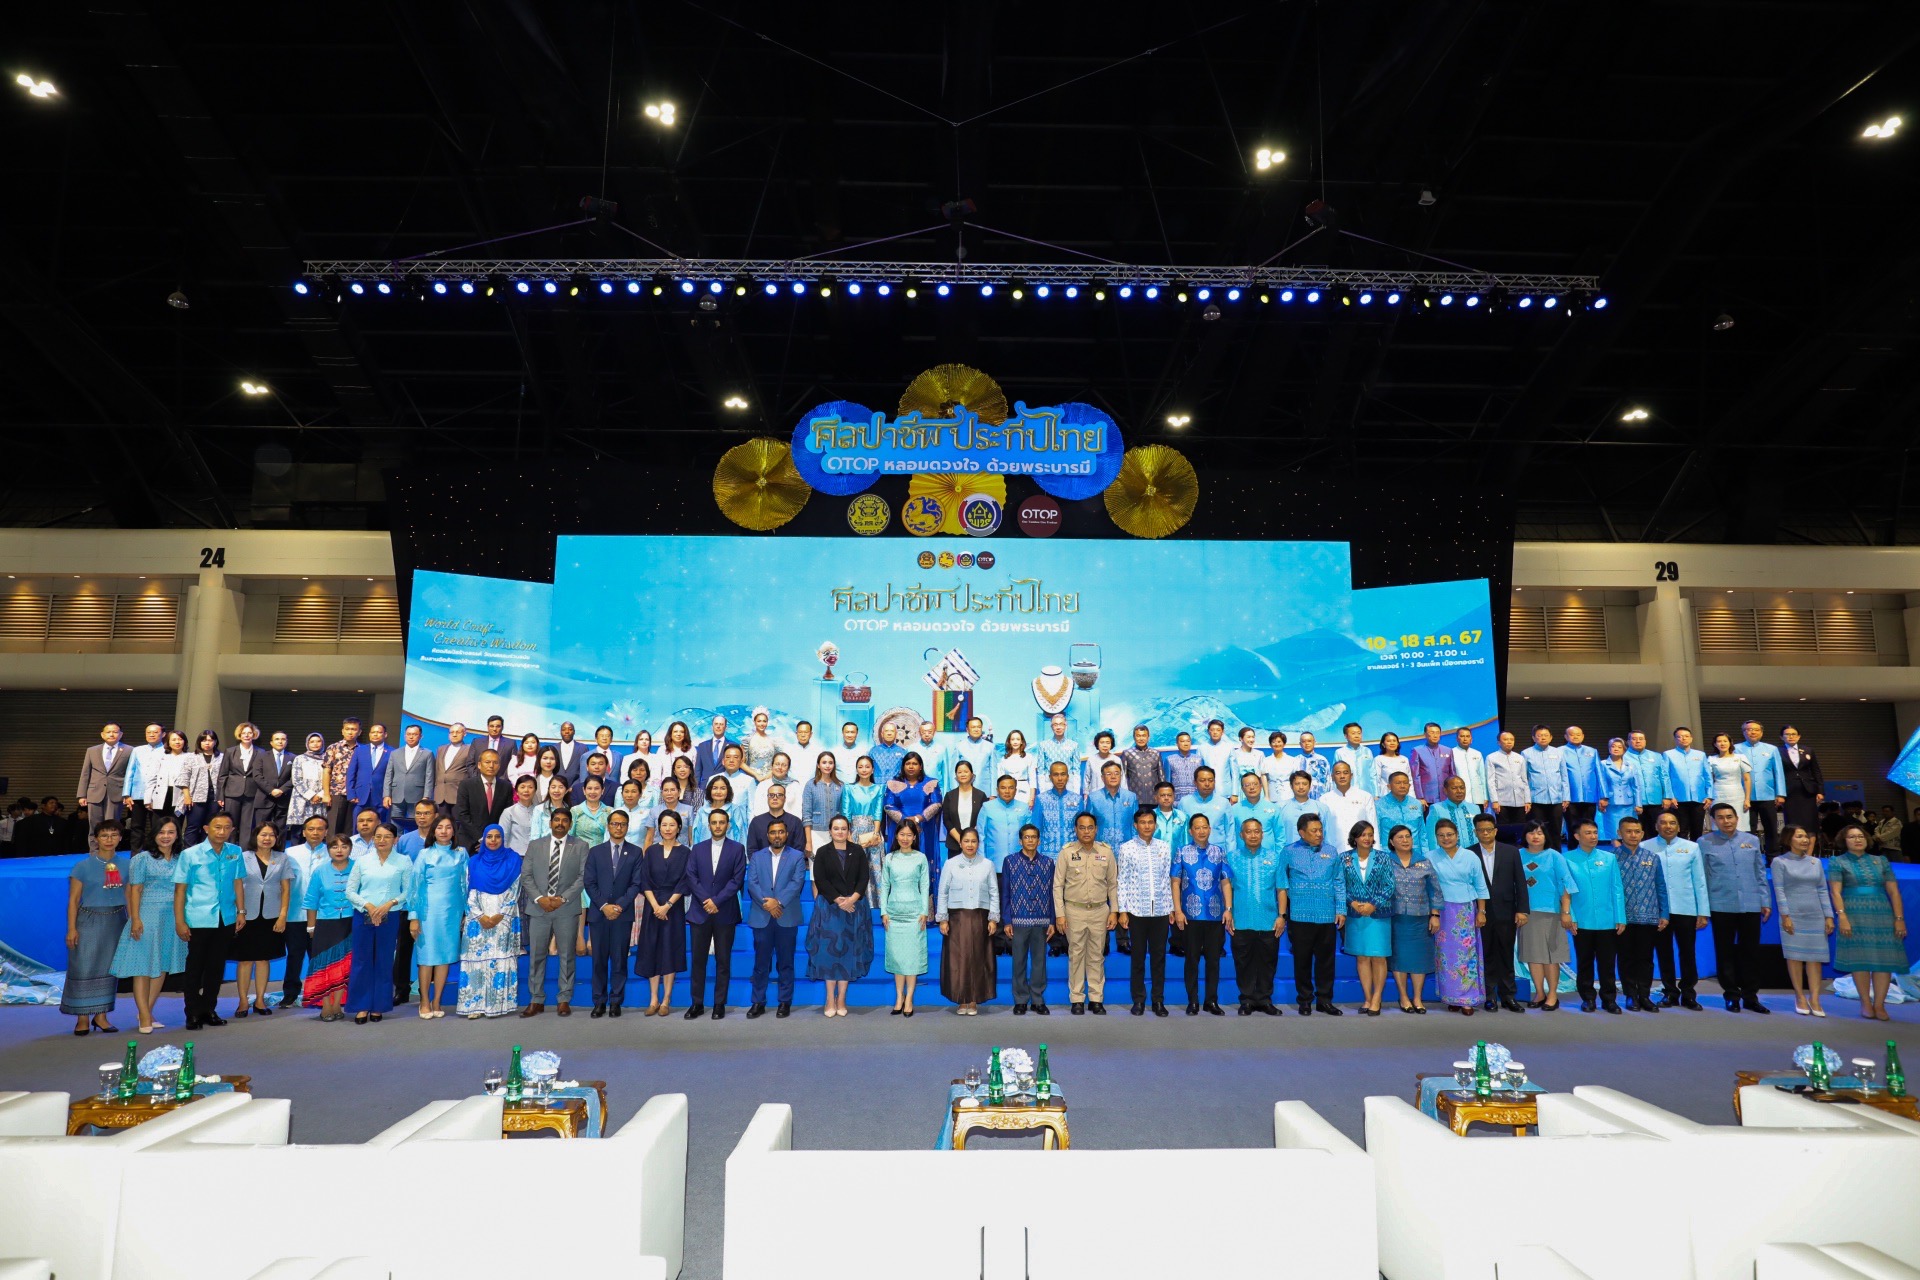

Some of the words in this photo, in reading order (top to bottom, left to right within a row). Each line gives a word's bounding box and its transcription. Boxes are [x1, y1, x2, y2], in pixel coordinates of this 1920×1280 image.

[950, 406, 1103, 452] ประทีปไทย
[827, 456, 879, 471] OTOP
[884, 458, 980, 472] หลอมดวงใจ
[986, 457, 1091, 474] ด้วยพระบารมี
[1021, 508, 1058, 520] OTOP
[199, 547, 226, 568] 24
[1654, 561, 1680, 582] 29
[949, 573, 1080, 613] ประทีปไทย
[424, 618, 459, 630] World
[462, 620, 493, 636] Craft
[844, 619, 889, 631] OTOP
[893, 620, 975, 632] หลอมดวงใจ
[980, 619, 1070, 633] ด้วยพระบารมี
[433, 632, 488, 648] Creative
[490, 637, 539, 652] Wisdom
[1366, 636, 1387, 650] 10
[1400, 634, 1420, 648] 18
[1423, 634, 1456, 647] ส.ค.
[1459, 629, 1482, 645] 67
[1380, 653, 1398, 661] เวลา
[1400, 651, 1424, 660] 10.00
[1434, 649, 1458, 658] 21.00
